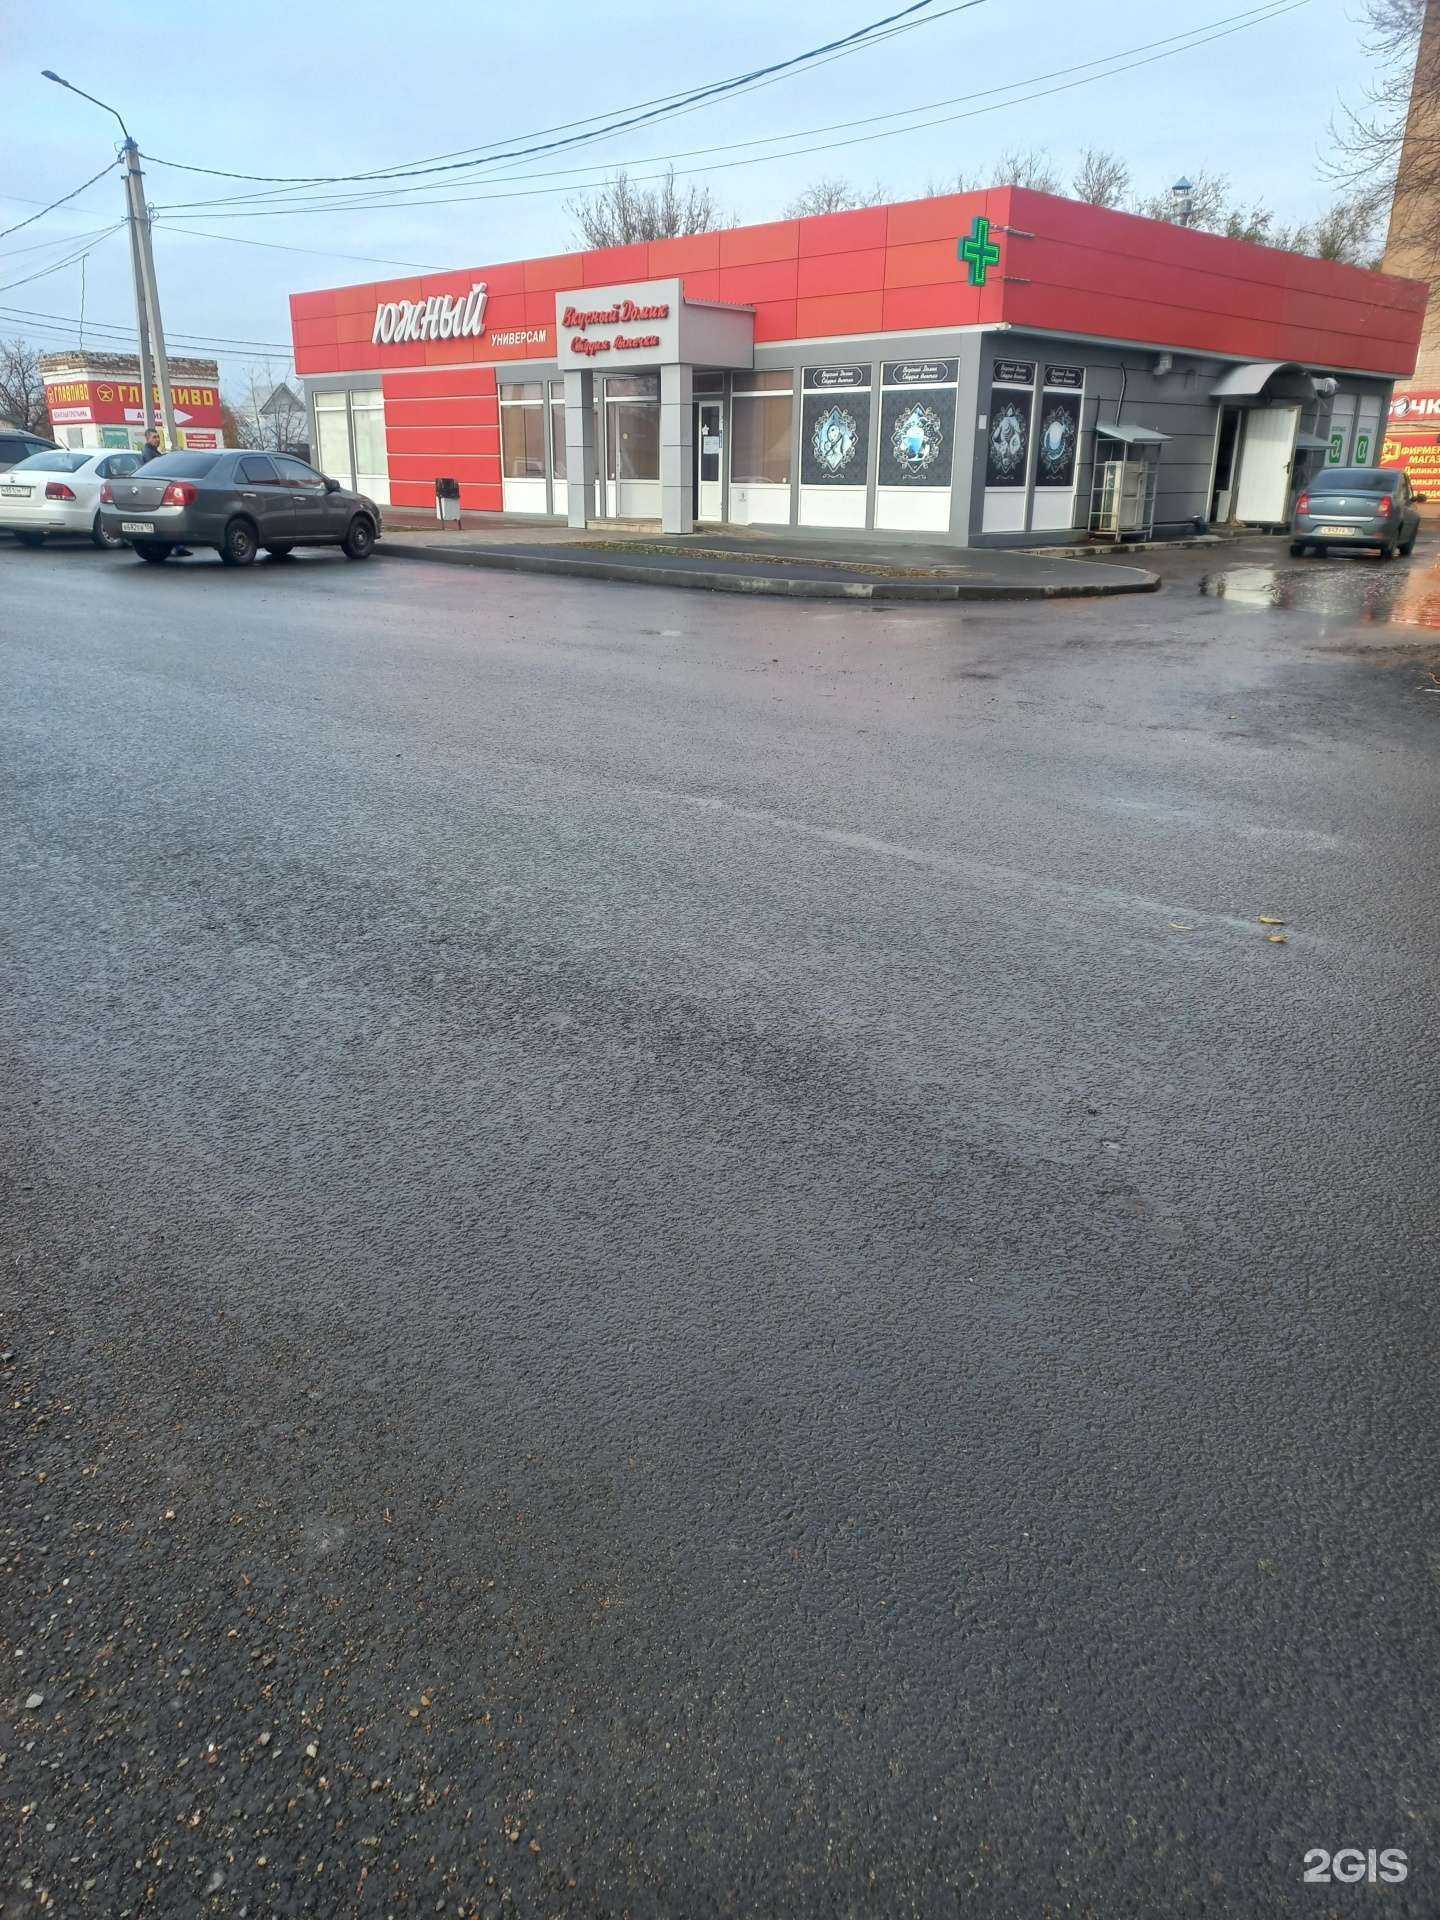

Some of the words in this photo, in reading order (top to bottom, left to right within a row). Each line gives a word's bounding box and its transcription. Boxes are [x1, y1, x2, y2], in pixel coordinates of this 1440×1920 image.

[372, 282, 488, 345] ЮЖНЫЙ
[562, 304, 621, 331] Вкусный
[621, 299, 669, 322] Домик
[491, 330, 547, 346] УНИВЕРСАМ
